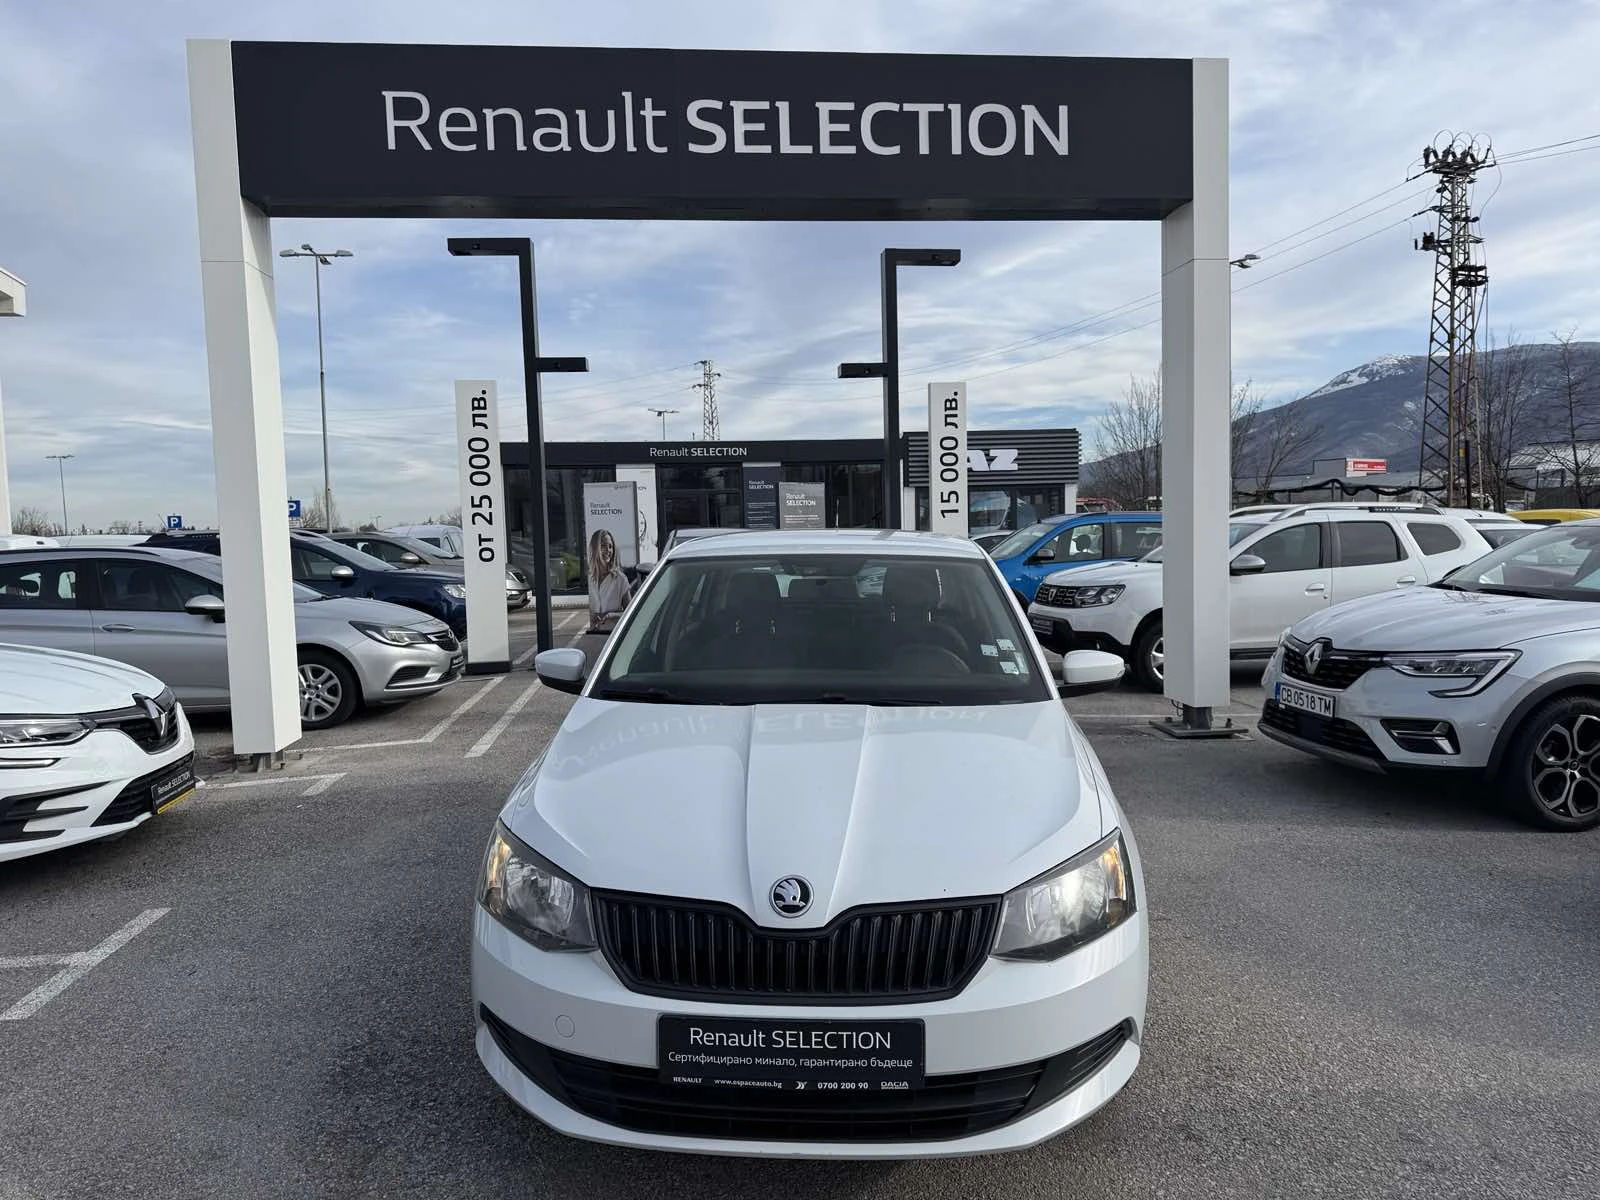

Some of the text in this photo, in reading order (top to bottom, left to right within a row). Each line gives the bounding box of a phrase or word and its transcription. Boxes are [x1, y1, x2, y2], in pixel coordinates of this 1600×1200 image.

[381, 90, 1070, 157] Renault SELECTION
[467, 436, 491, 487] 000
[649, 447, 747, 457] Renault SELECTION
[939, 436, 959, 482] 000
[470, 494, 493, 526] 25
[590, 508, 622, 516] SELECTION
[940, 490, 960, 519] 15
[478, 533, 495, 563] от
[1281, 687, 1331, 716] CB 0518 TM
[690, 1027, 891, 1050] Renault SELECTION
[668, 1051, 913, 1069] Сертифицирано минало, гарантирано бъдеще
[673, 1076, 703, 1084] RENAULT
[714, 1079, 783, 1089] www.espaceauto.bg
